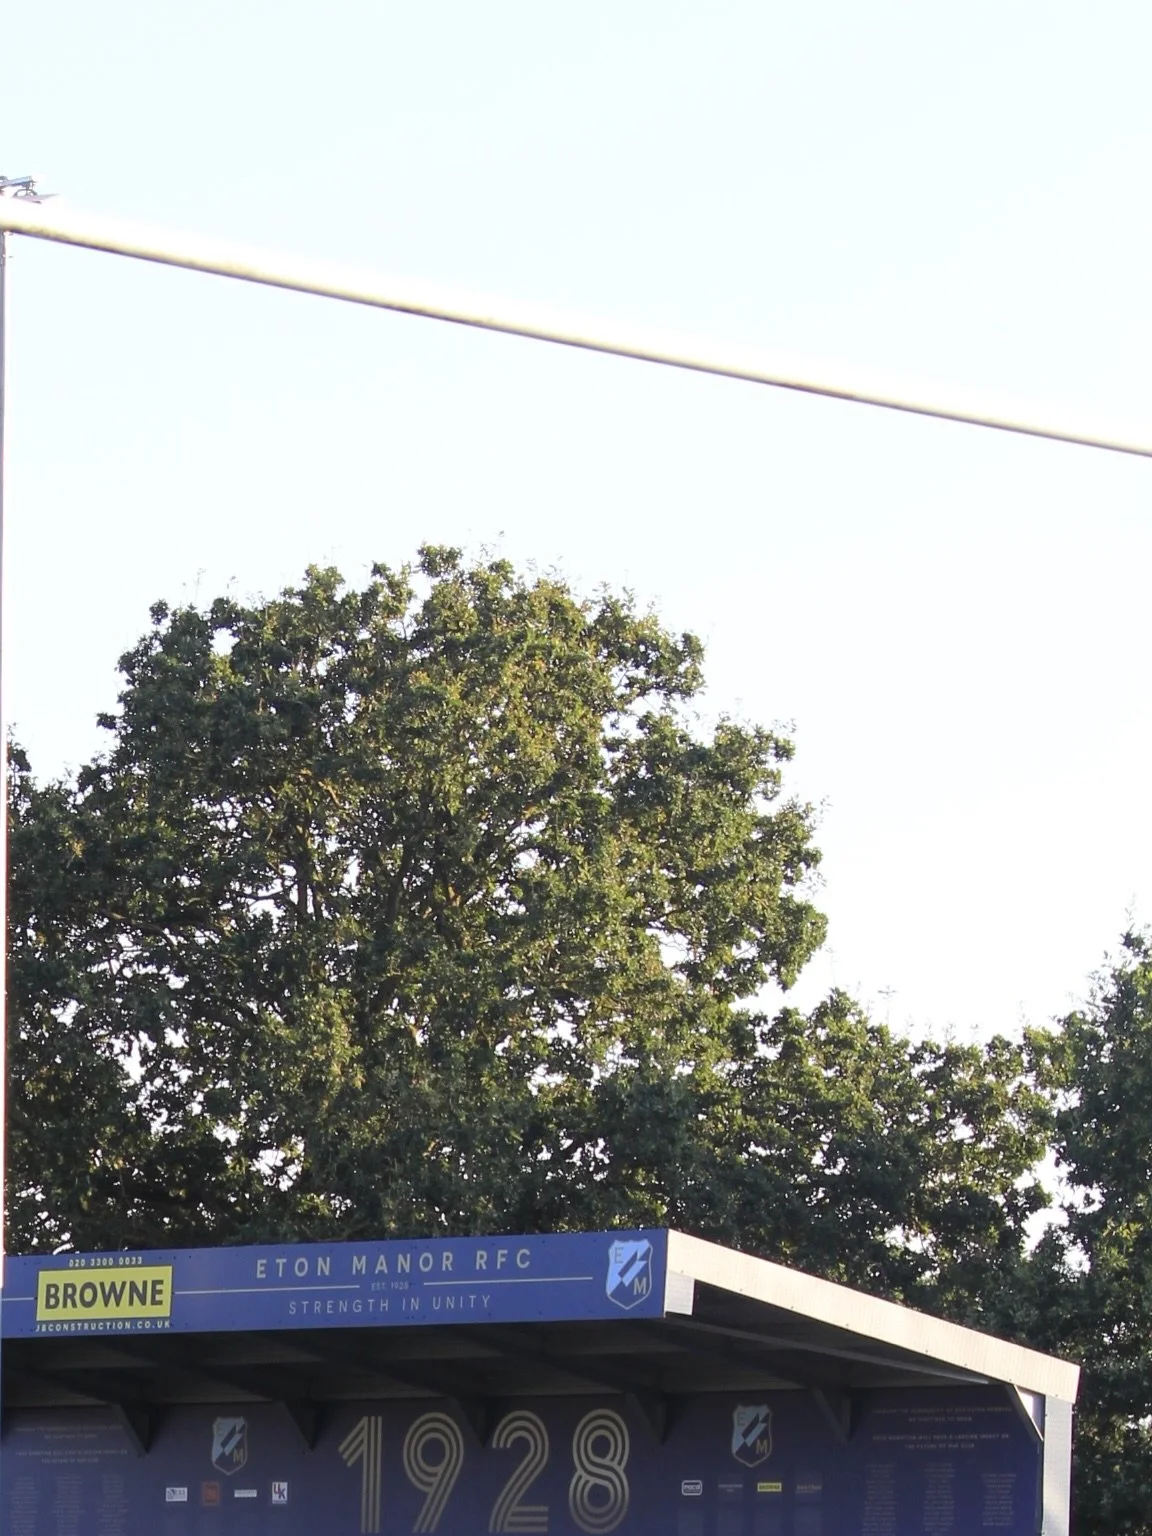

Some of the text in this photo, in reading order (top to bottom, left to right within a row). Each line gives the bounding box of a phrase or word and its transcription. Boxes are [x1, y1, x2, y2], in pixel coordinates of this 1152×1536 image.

[69, 1258, 86, 1267] 020
[91, 1258, 114, 1266] 3300
[256, 1248, 532, 1278] ETON MANOR RFC
[45, 1279, 164, 1310] BROWNE
[633, 1278, 647, 1296] M
[288, 1294, 491, 1315] STRENGTH IN UNITY
[35, 1320, 171, 1333] JBCONSTRUCTION.CO.UK
[756, 1439, 769, 1456] M
[233, 1450, 245, 1464] M
[338, 1408, 630, 1535] 1928
